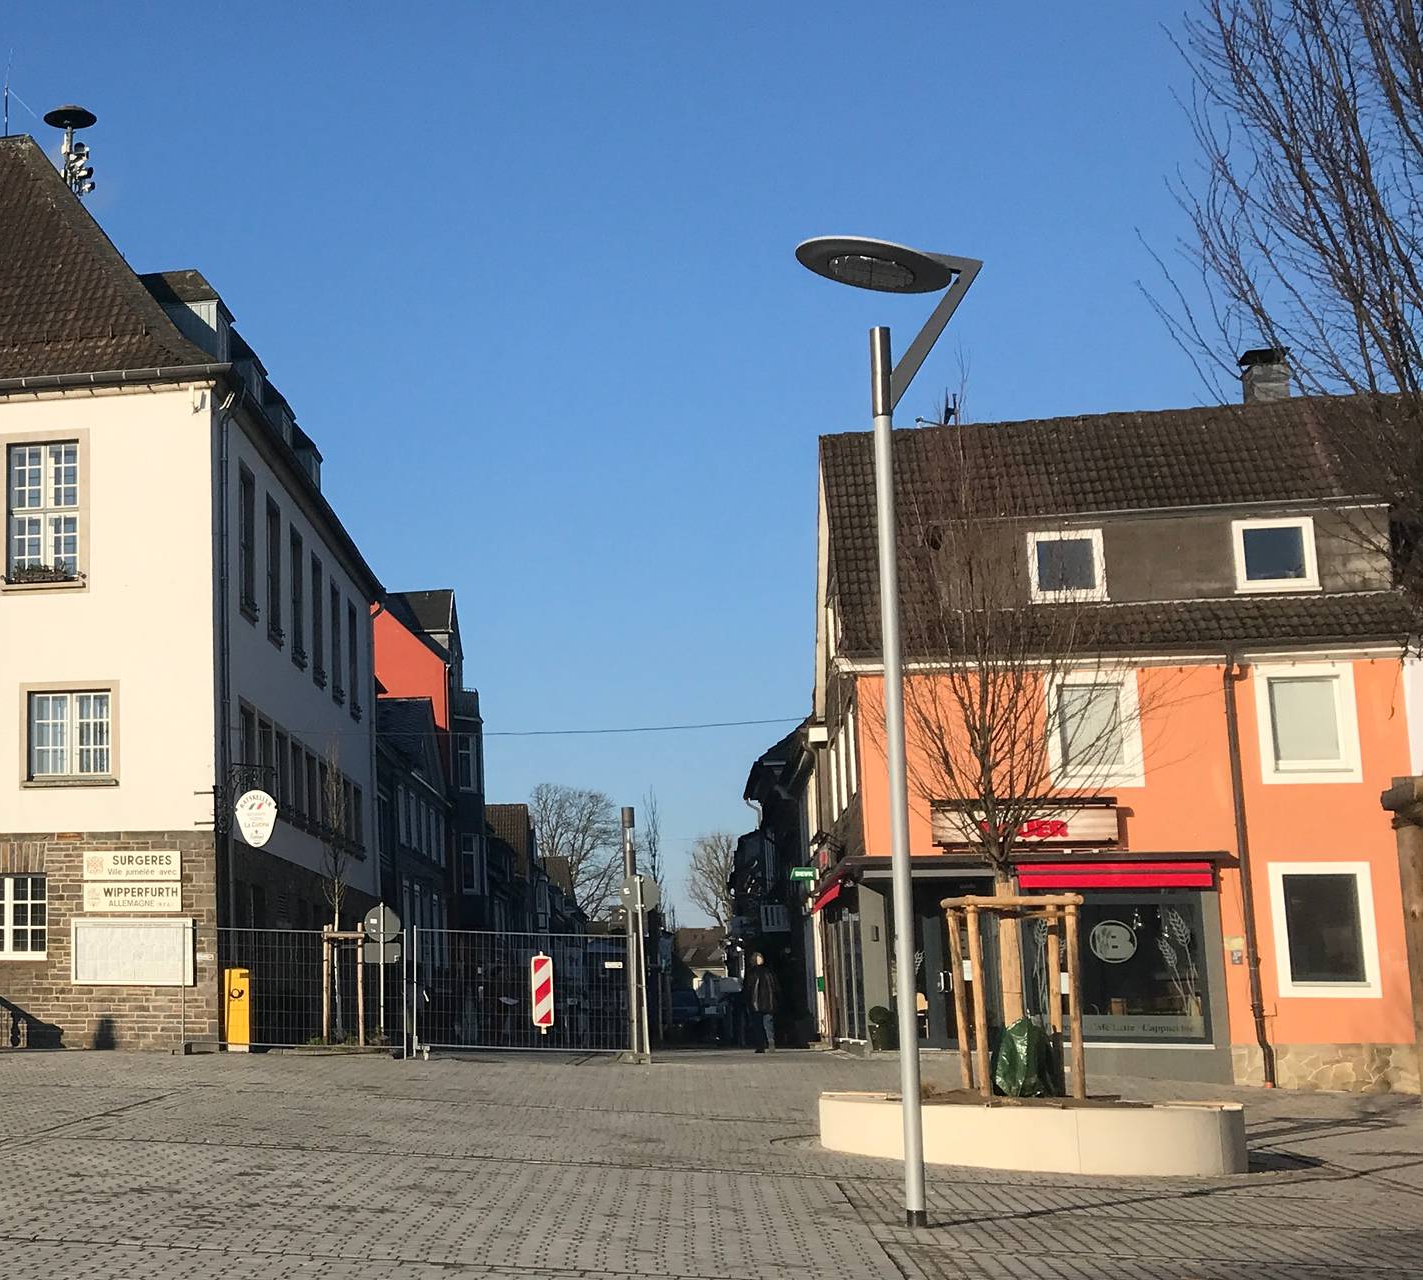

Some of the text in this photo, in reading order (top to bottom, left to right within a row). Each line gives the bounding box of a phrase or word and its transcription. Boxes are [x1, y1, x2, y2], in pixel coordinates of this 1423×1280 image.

[112, 855, 172, 865] SURGERES
[107, 868, 123, 876] Ville
[126, 868, 155, 877] jumelée
[103, 887, 178, 897] WIPPERFURTH
[108, 899, 155, 907] ALLEMAGNE
